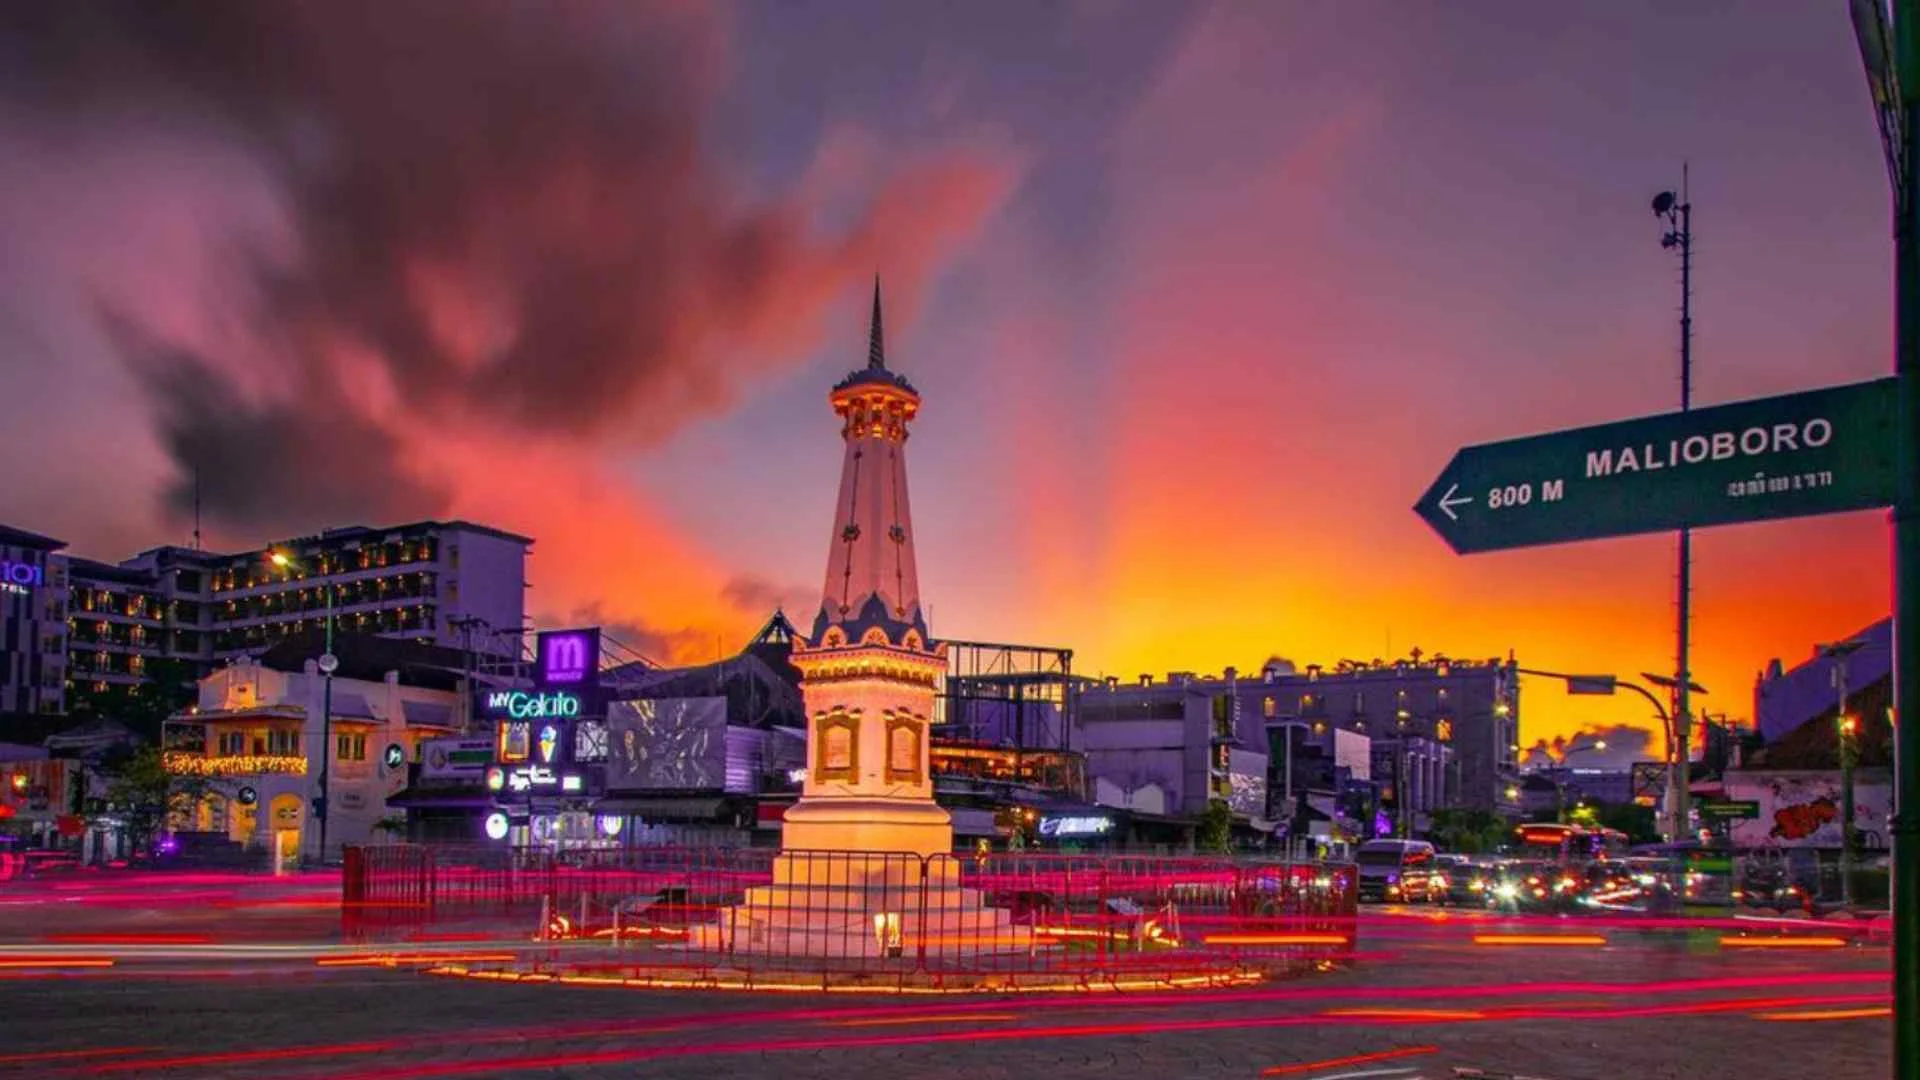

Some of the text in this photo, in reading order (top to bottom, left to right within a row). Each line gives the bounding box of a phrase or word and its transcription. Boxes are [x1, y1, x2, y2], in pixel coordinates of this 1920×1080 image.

[1585, 417, 1833, 479] MALIOBORO
[1487, 479, 1564, 509] 800 M
[488, 691, 578, 718] MY Gelato
